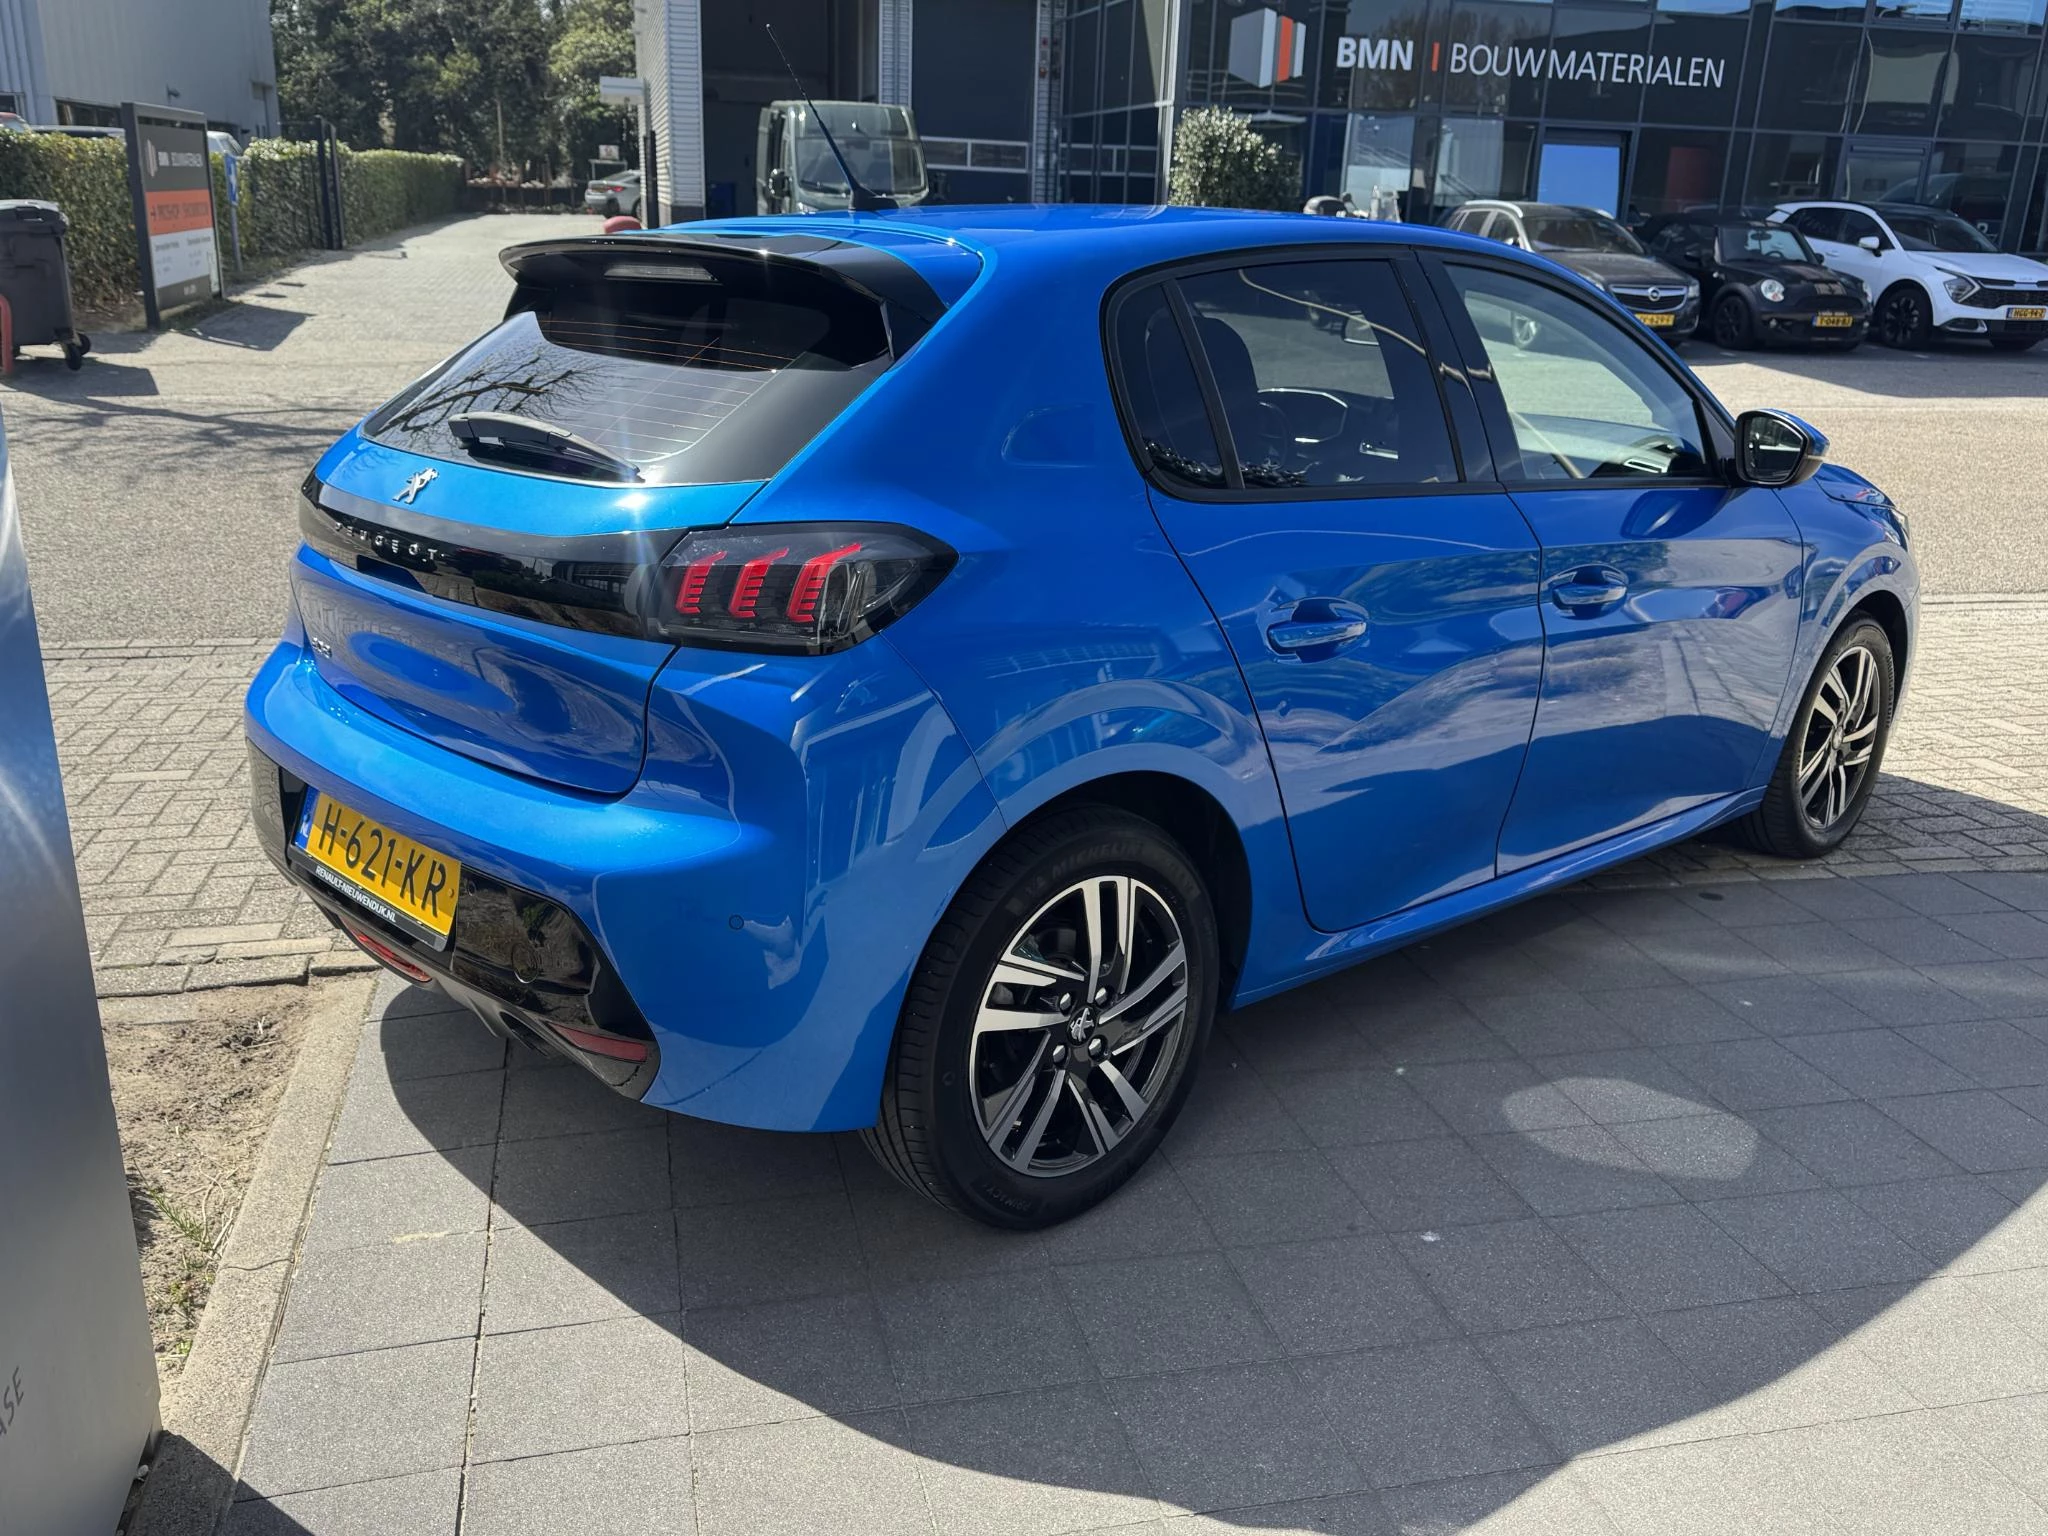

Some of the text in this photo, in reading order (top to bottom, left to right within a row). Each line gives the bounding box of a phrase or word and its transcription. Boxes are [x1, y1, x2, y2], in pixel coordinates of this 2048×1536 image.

[1336, 36, 1726, 88] BMN BOUWMATERIALEN
[318, 803, 447, 919] H-621-KR
[1051, 840, 1145, 880] MICHELIN
